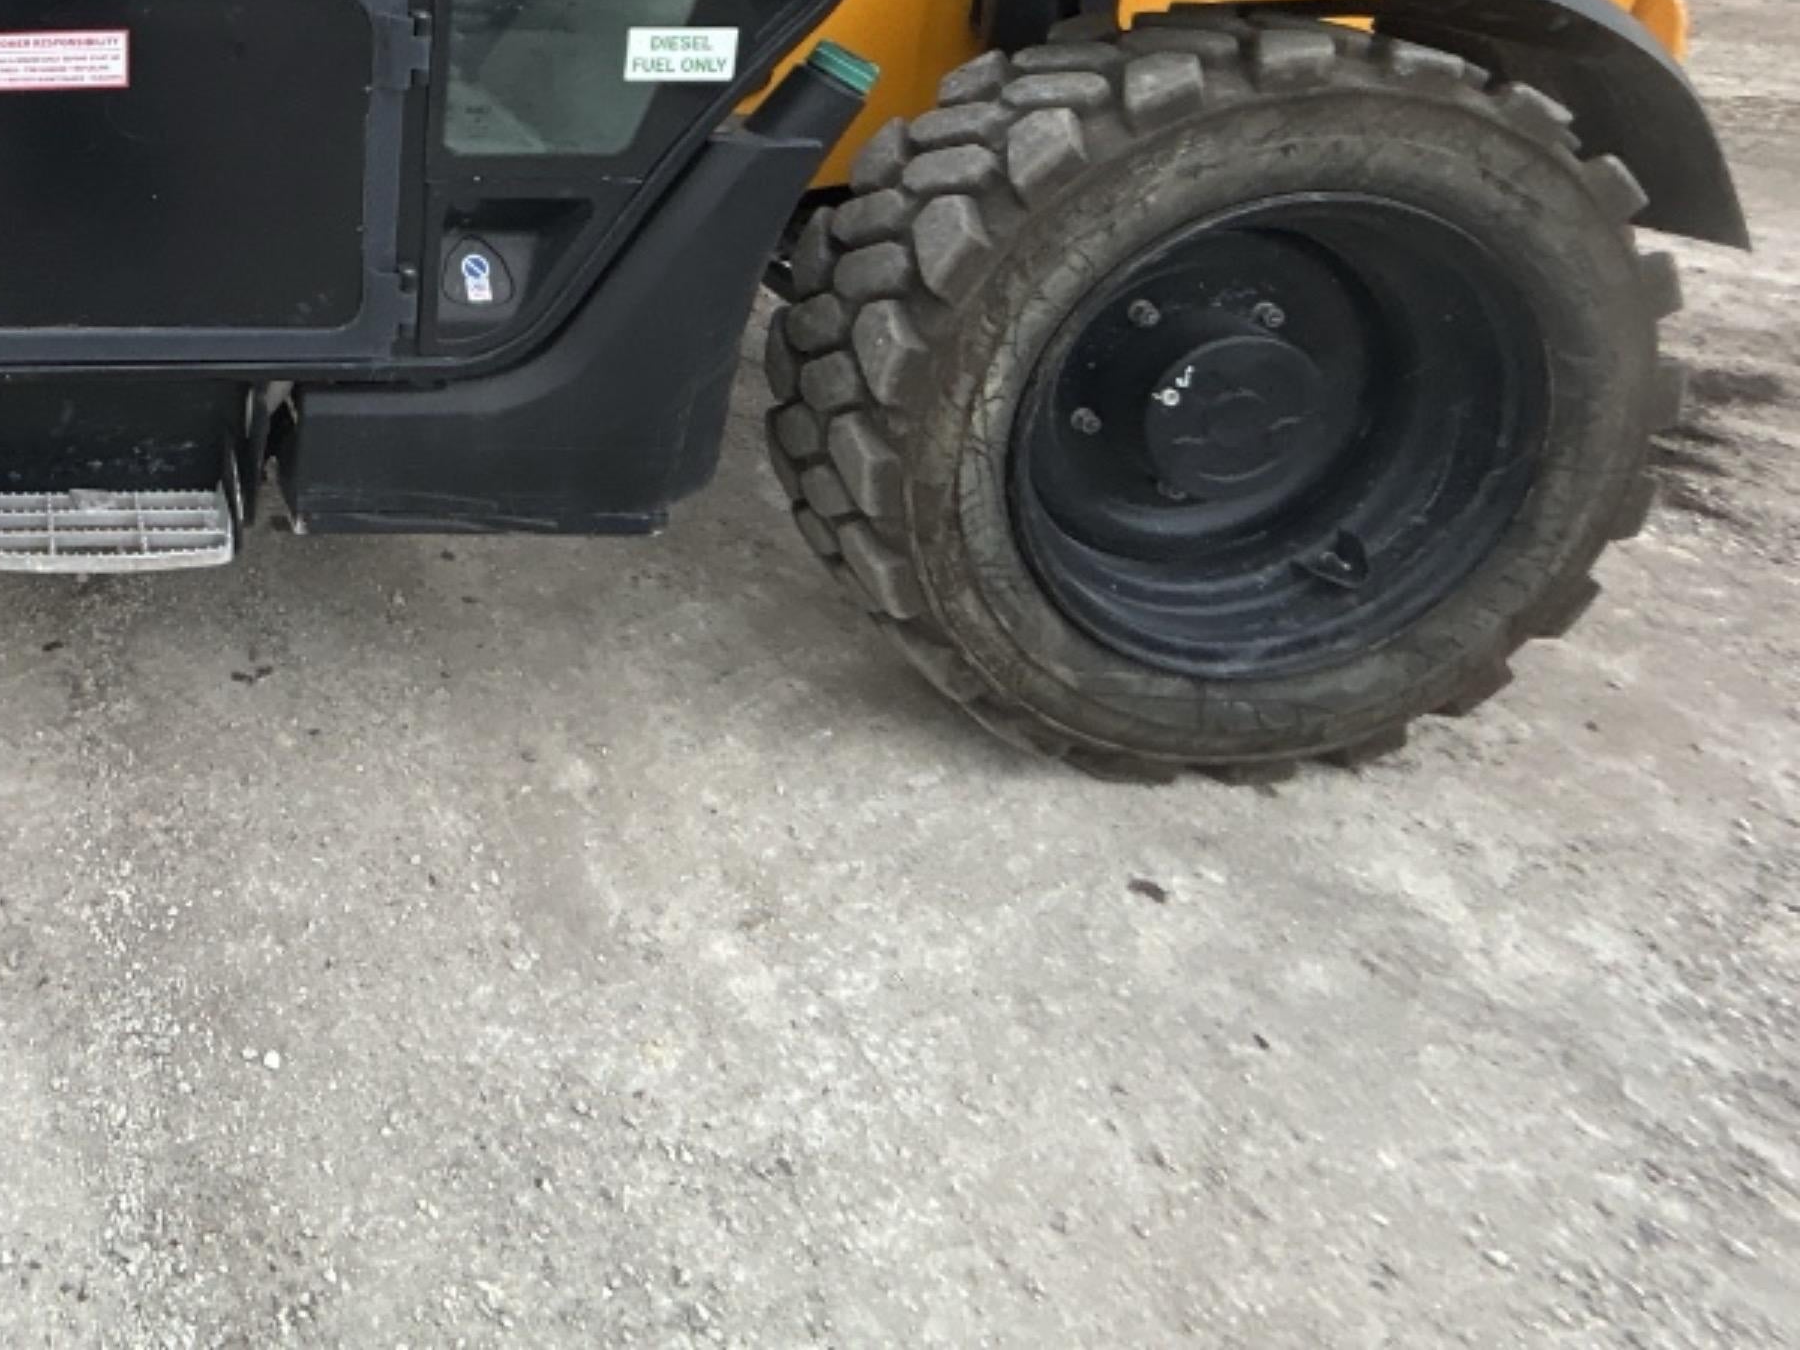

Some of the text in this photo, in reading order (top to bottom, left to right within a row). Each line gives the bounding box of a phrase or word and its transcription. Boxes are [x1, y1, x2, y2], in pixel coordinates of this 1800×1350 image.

[650, 35, 715, 52] DIESEL
[632, 56, 727, 73] FUEL ONLY
